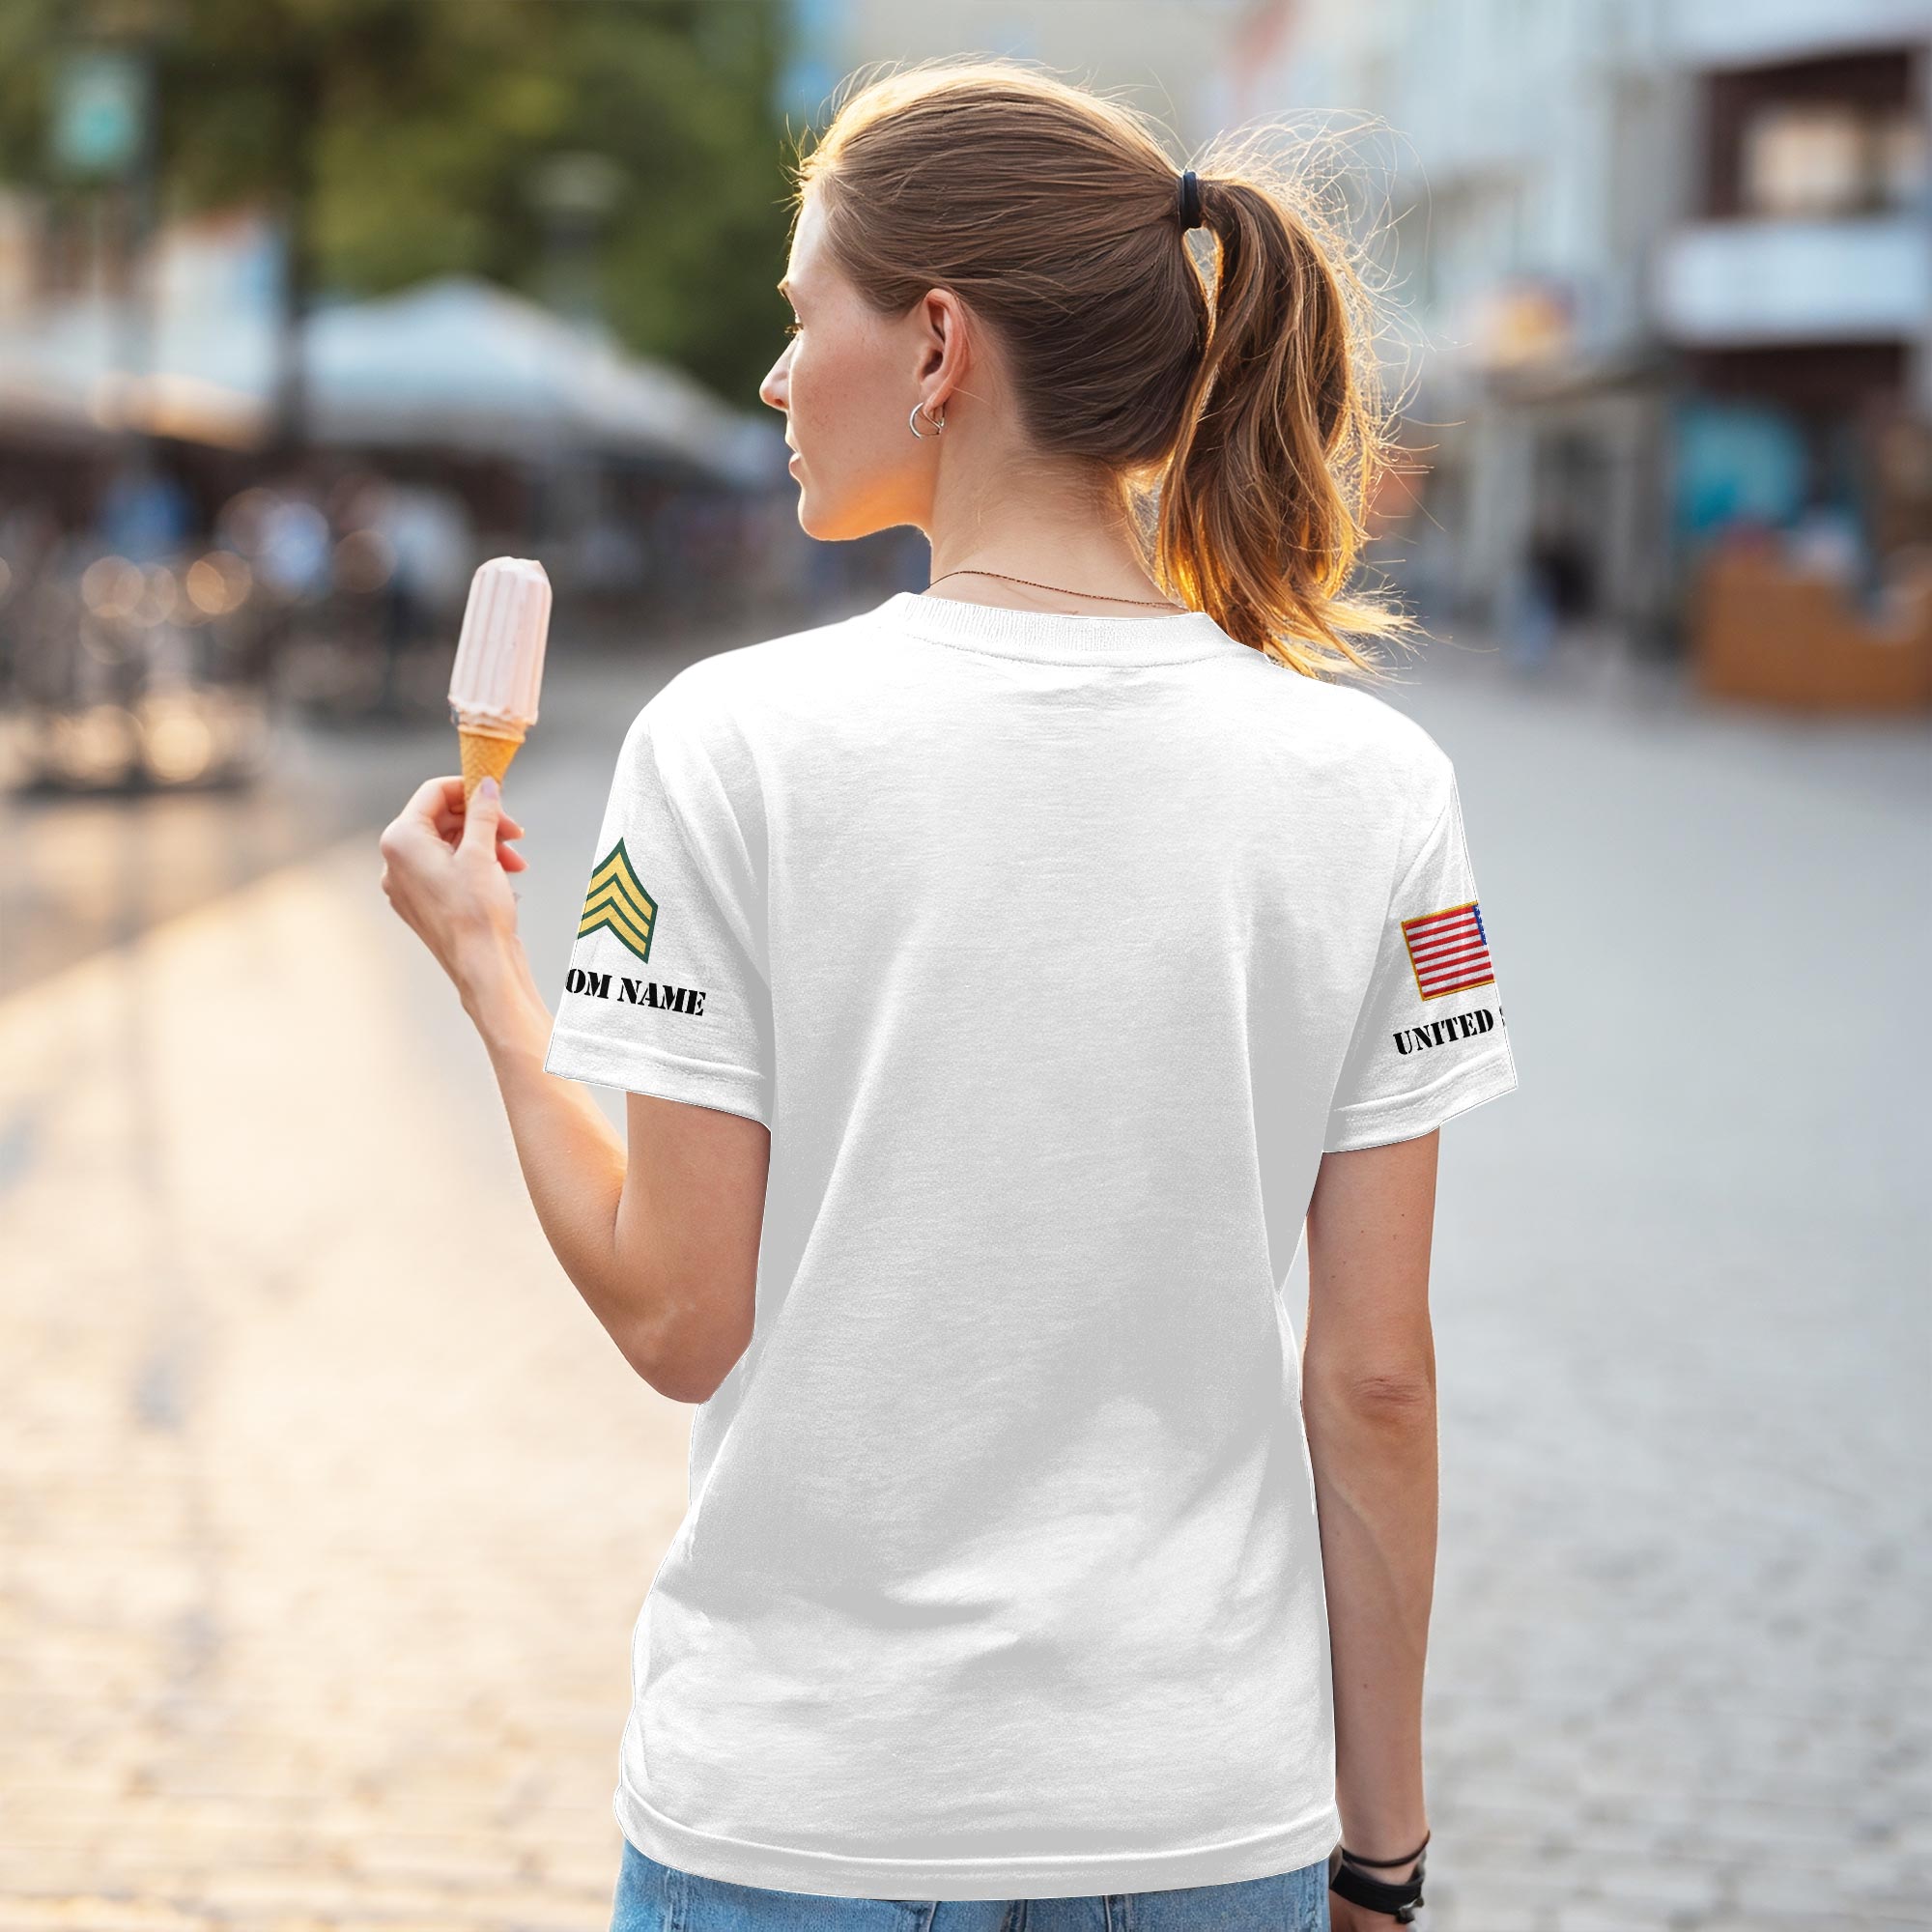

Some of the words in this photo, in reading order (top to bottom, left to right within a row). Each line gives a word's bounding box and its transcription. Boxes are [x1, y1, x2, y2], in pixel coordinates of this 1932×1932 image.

[566, 969, 612, 1000] OM
[616, 977, 706, 1017] NAME
[1393, 1009, 1493, 1056] UNITED
